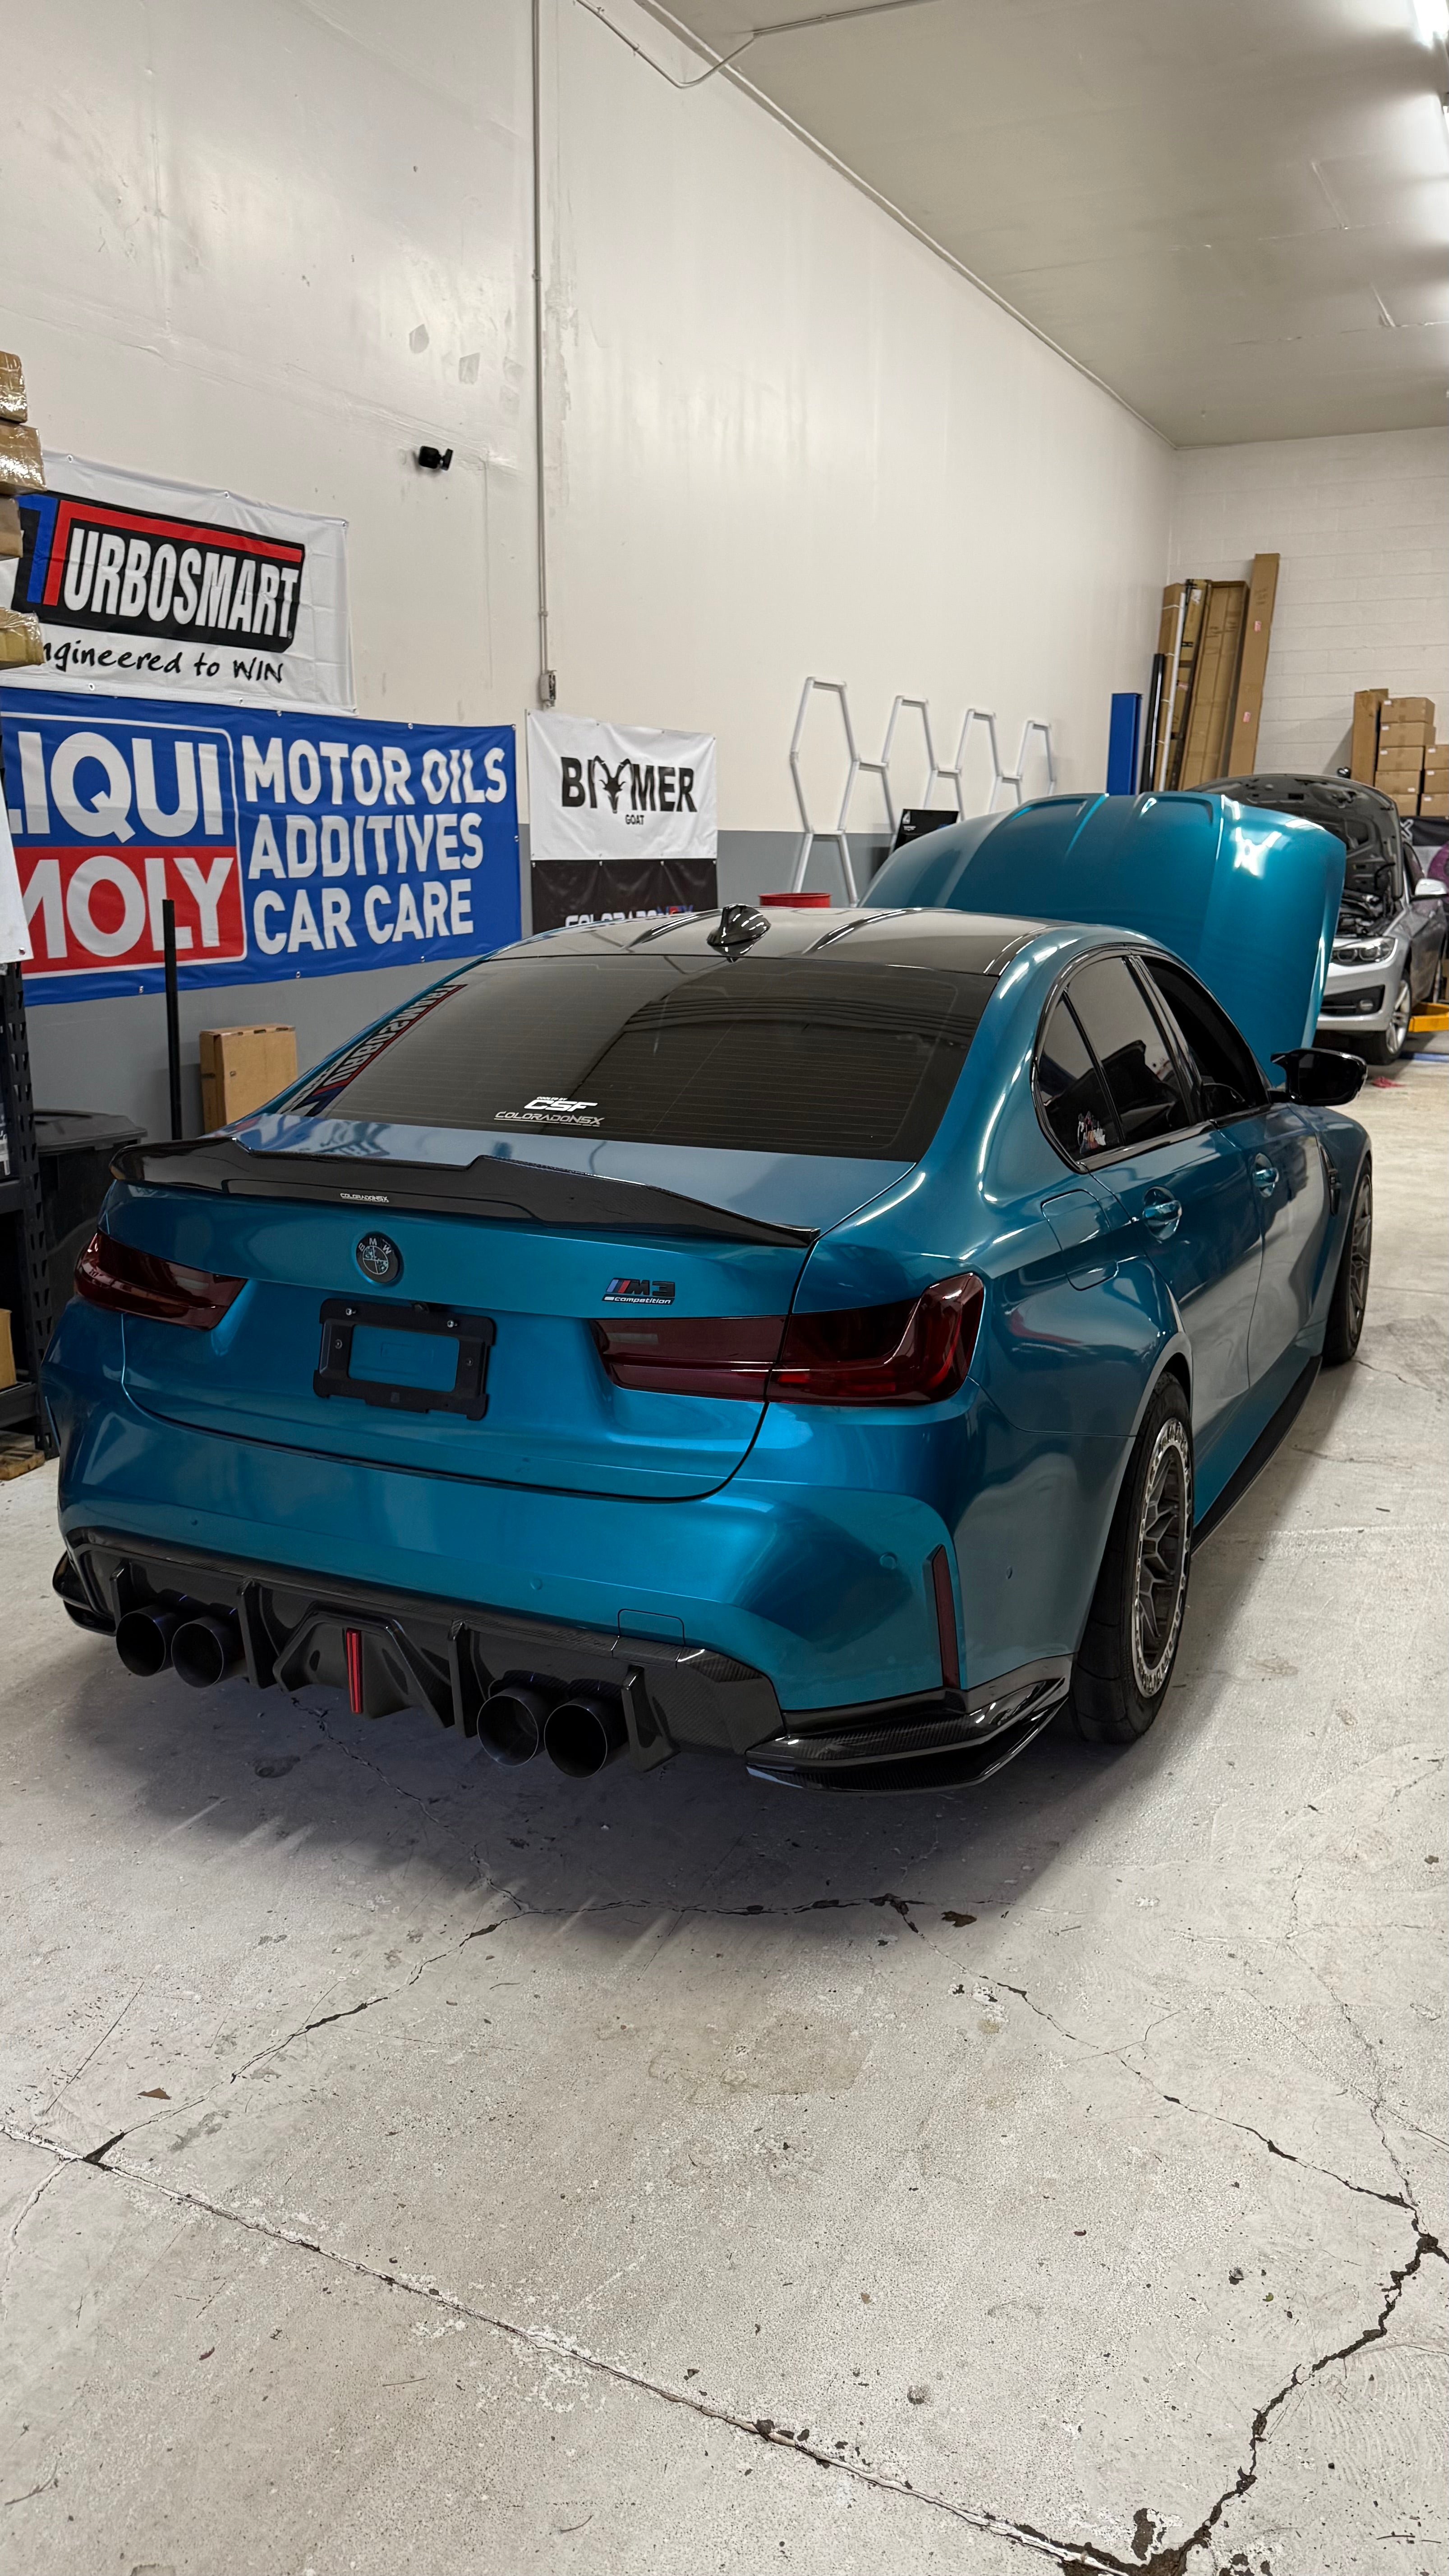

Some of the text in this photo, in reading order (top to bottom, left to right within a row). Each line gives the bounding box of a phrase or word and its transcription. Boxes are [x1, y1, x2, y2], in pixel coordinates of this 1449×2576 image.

[17, 494, 303, 638] TURBOSMART
[43, 640, 283, 683] ngineered to WIN
[8, 731, 224, 842] IQUI
[241, 735, 507, 805] MOTOR OILS
[248, 812, 483, 879] ADDITIVES
[626, 814, 644, 825] GOAT
[253, 879, 474, 955] CAR CARE
[524, 1099, 598, 1112] CSF
[358, 1237, 391, 1254] BMW
